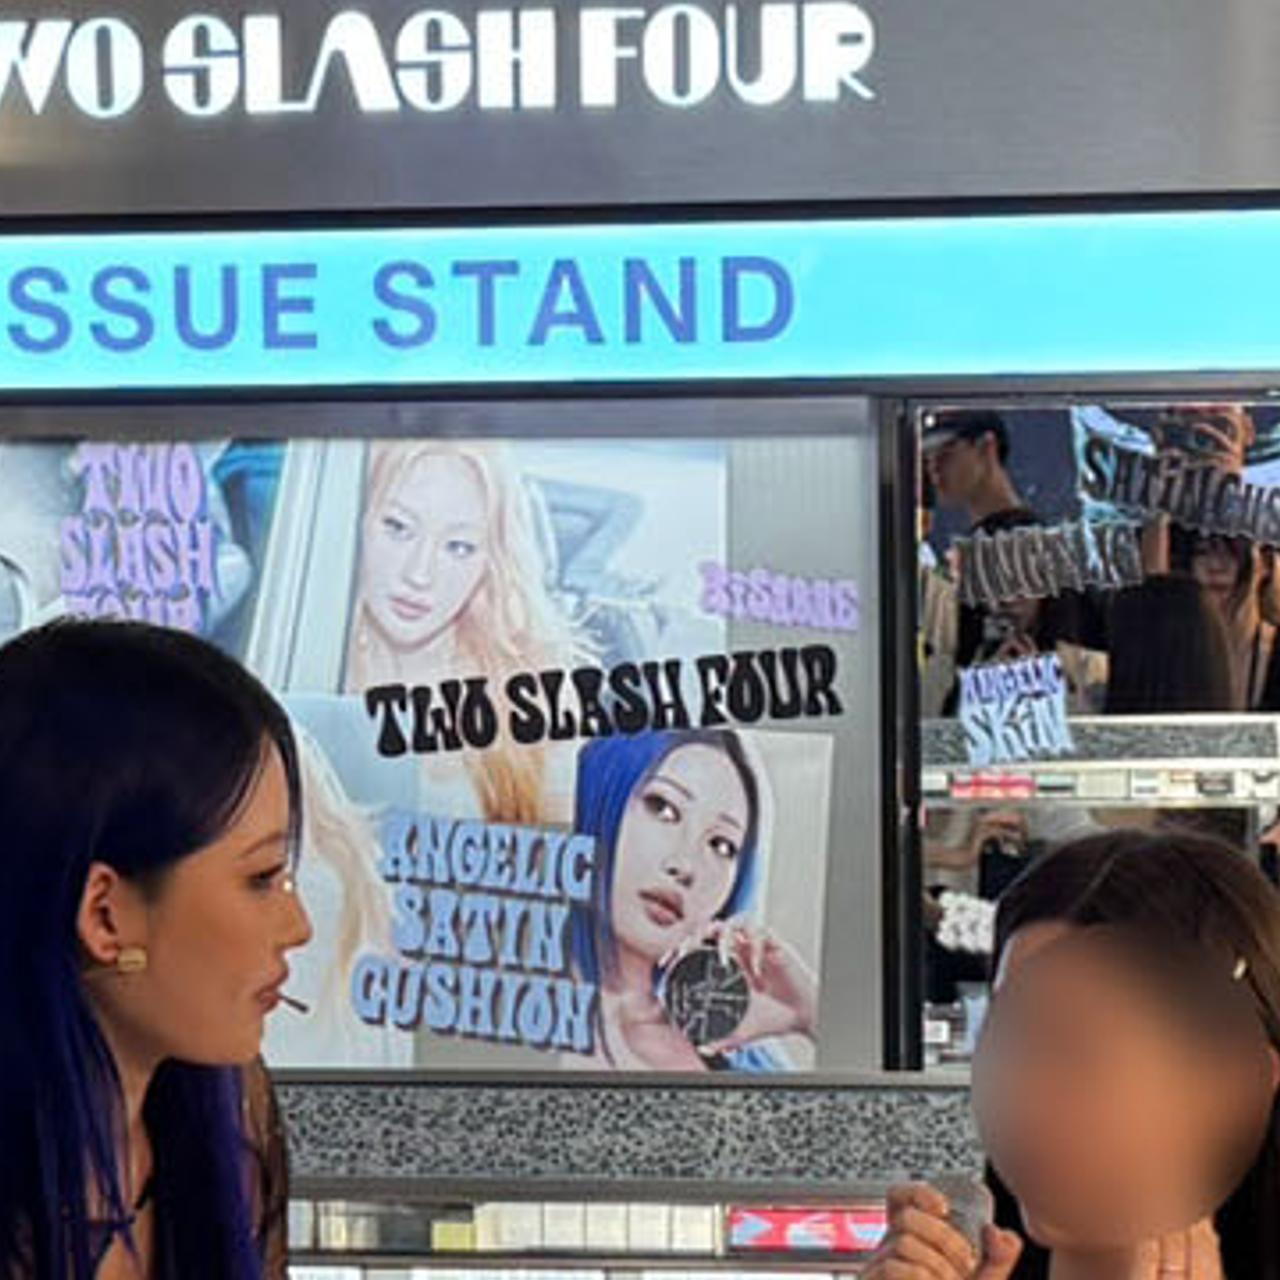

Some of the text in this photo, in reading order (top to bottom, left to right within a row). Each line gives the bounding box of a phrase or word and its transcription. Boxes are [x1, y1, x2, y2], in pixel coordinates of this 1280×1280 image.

[163, 9, 556, 116] SLASH
[579, 1, 876, 107] FOUR
[372, 256, 795, 350] STAND
[76, 440, 207, 523] TWO
[60, 516, 220, 596] SLASH
[366, 644, 843, 758] TWO SLASH FOUR
[376, 814, 598, 904] ANGELIC
[392, 881, 570, 976] SATIN
[351, 954, 597, 1056] CUSHION
